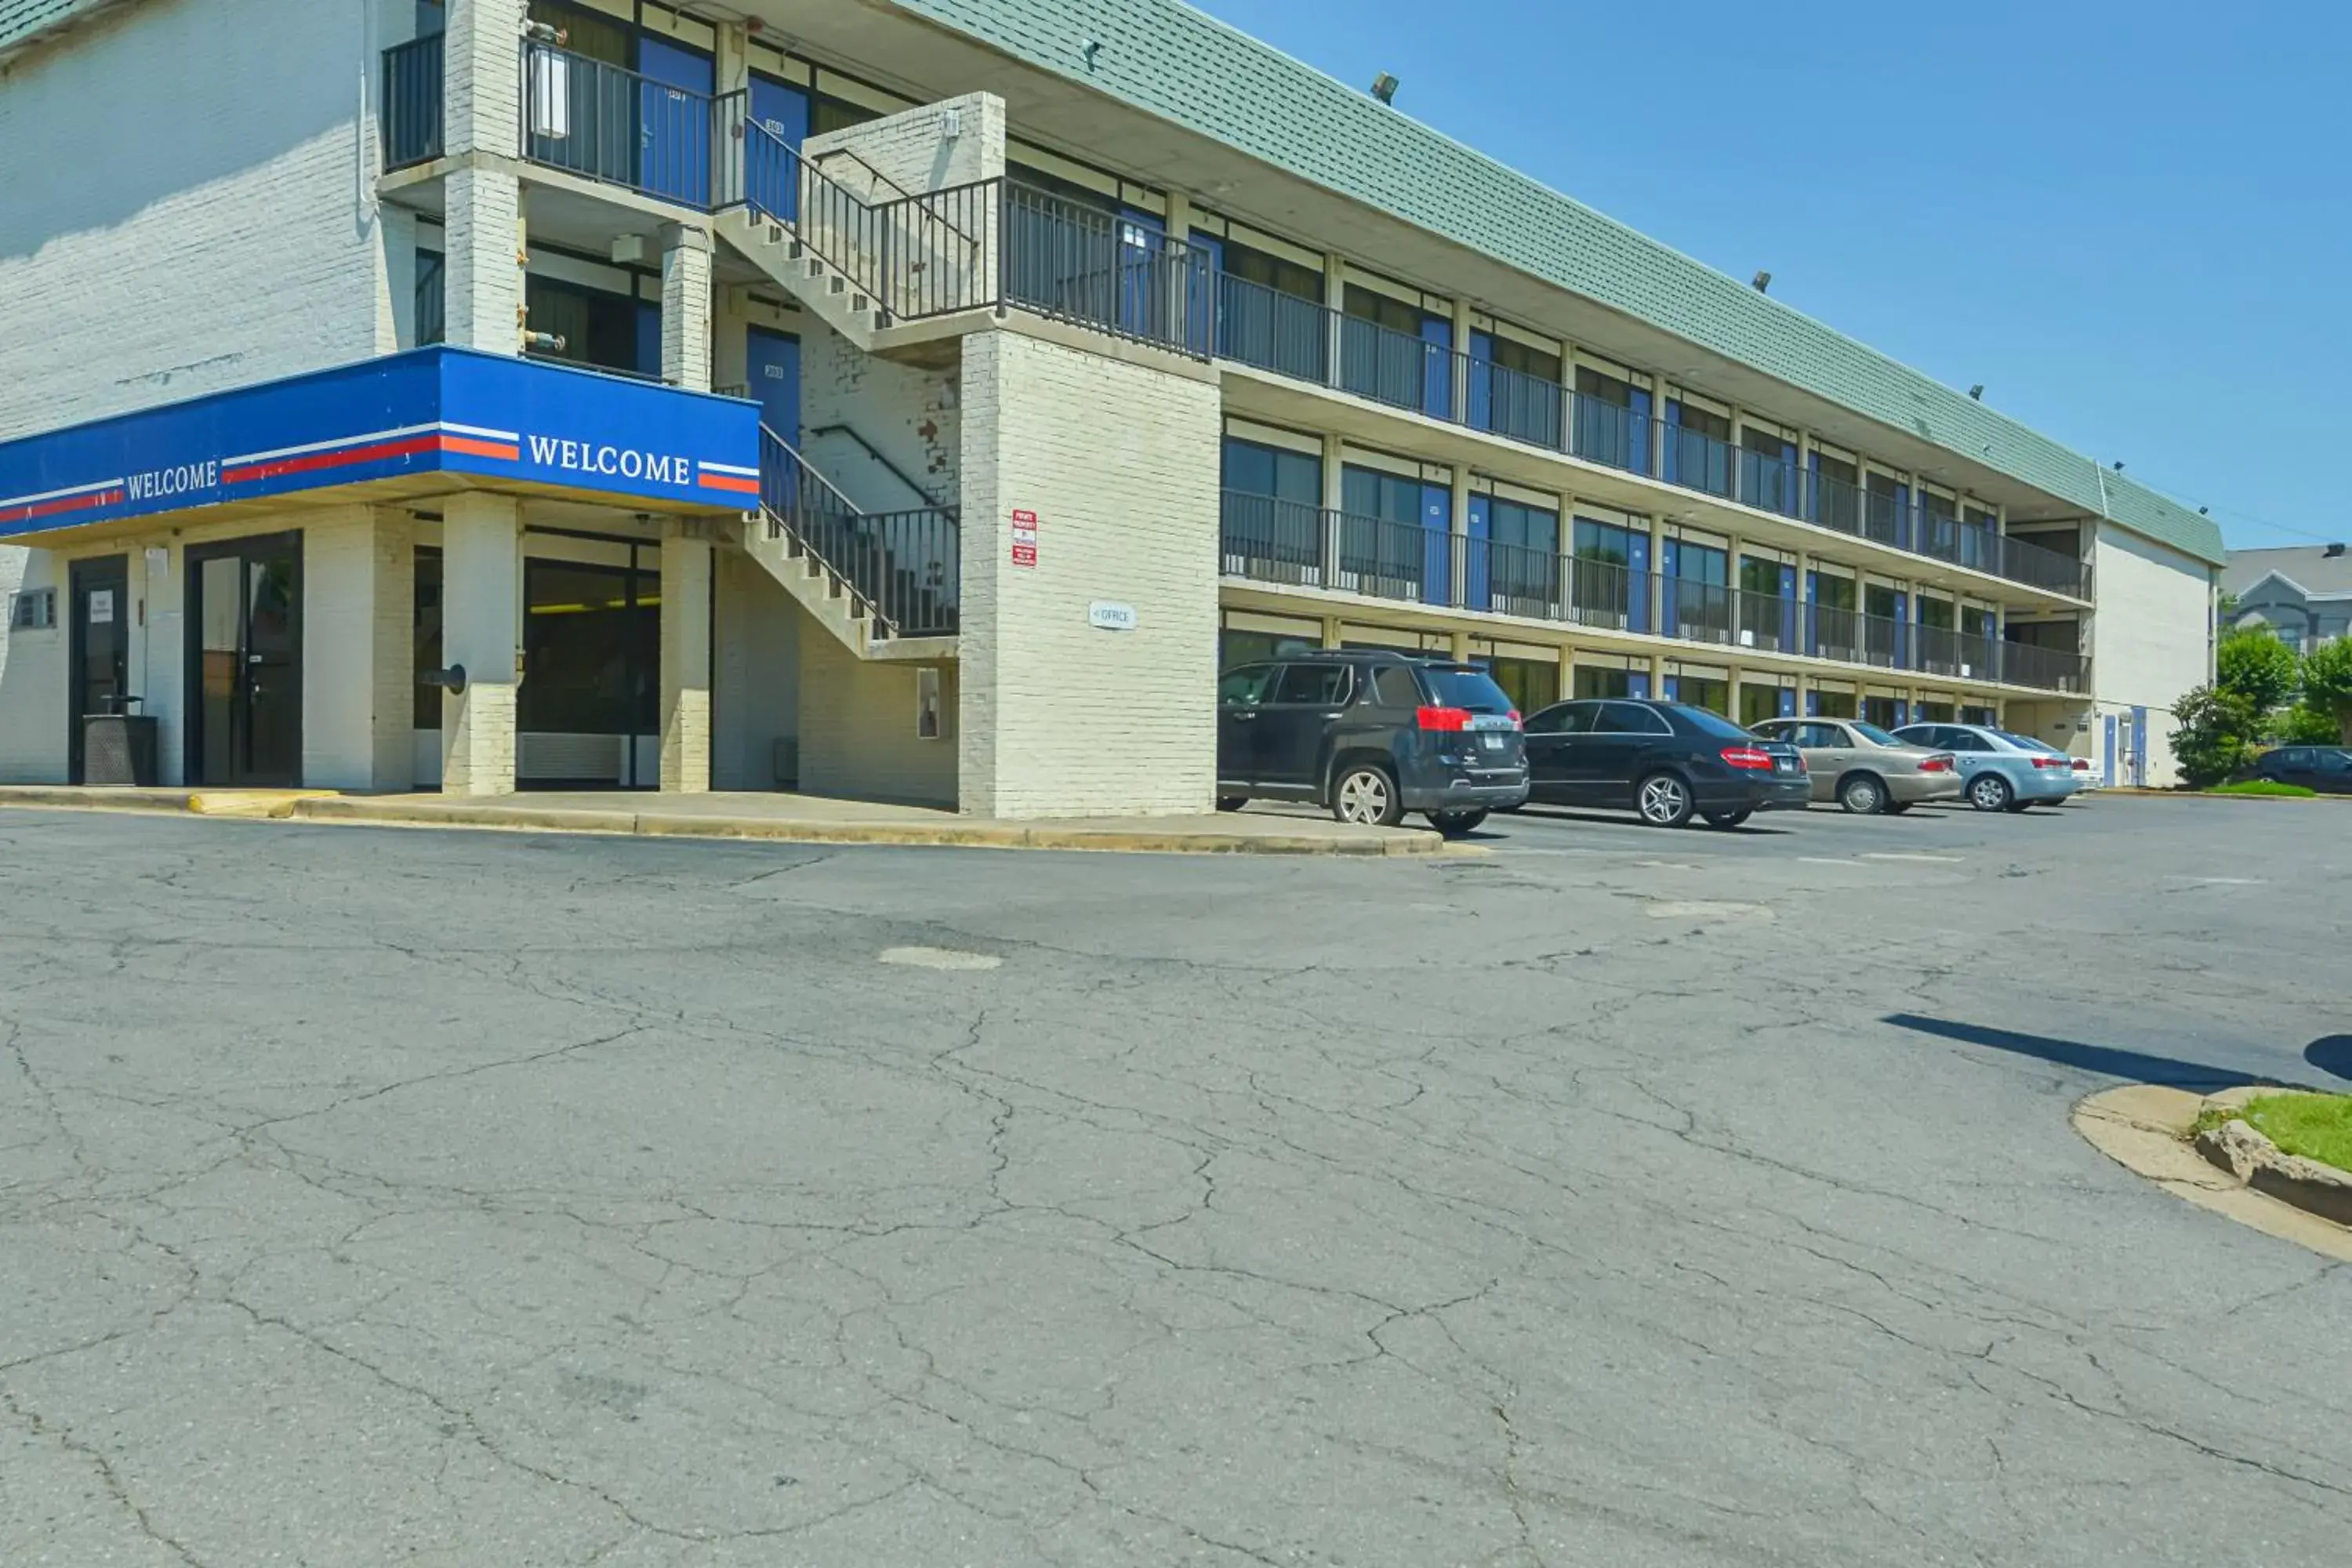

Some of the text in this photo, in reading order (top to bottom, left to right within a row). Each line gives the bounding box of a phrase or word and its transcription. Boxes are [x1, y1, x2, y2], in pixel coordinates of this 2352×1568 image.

[528, 434, 690, 485] WELCOME
[128, 460, 217, 500] WELCOME
[1101, 609, 1128, 622] OFFICE
